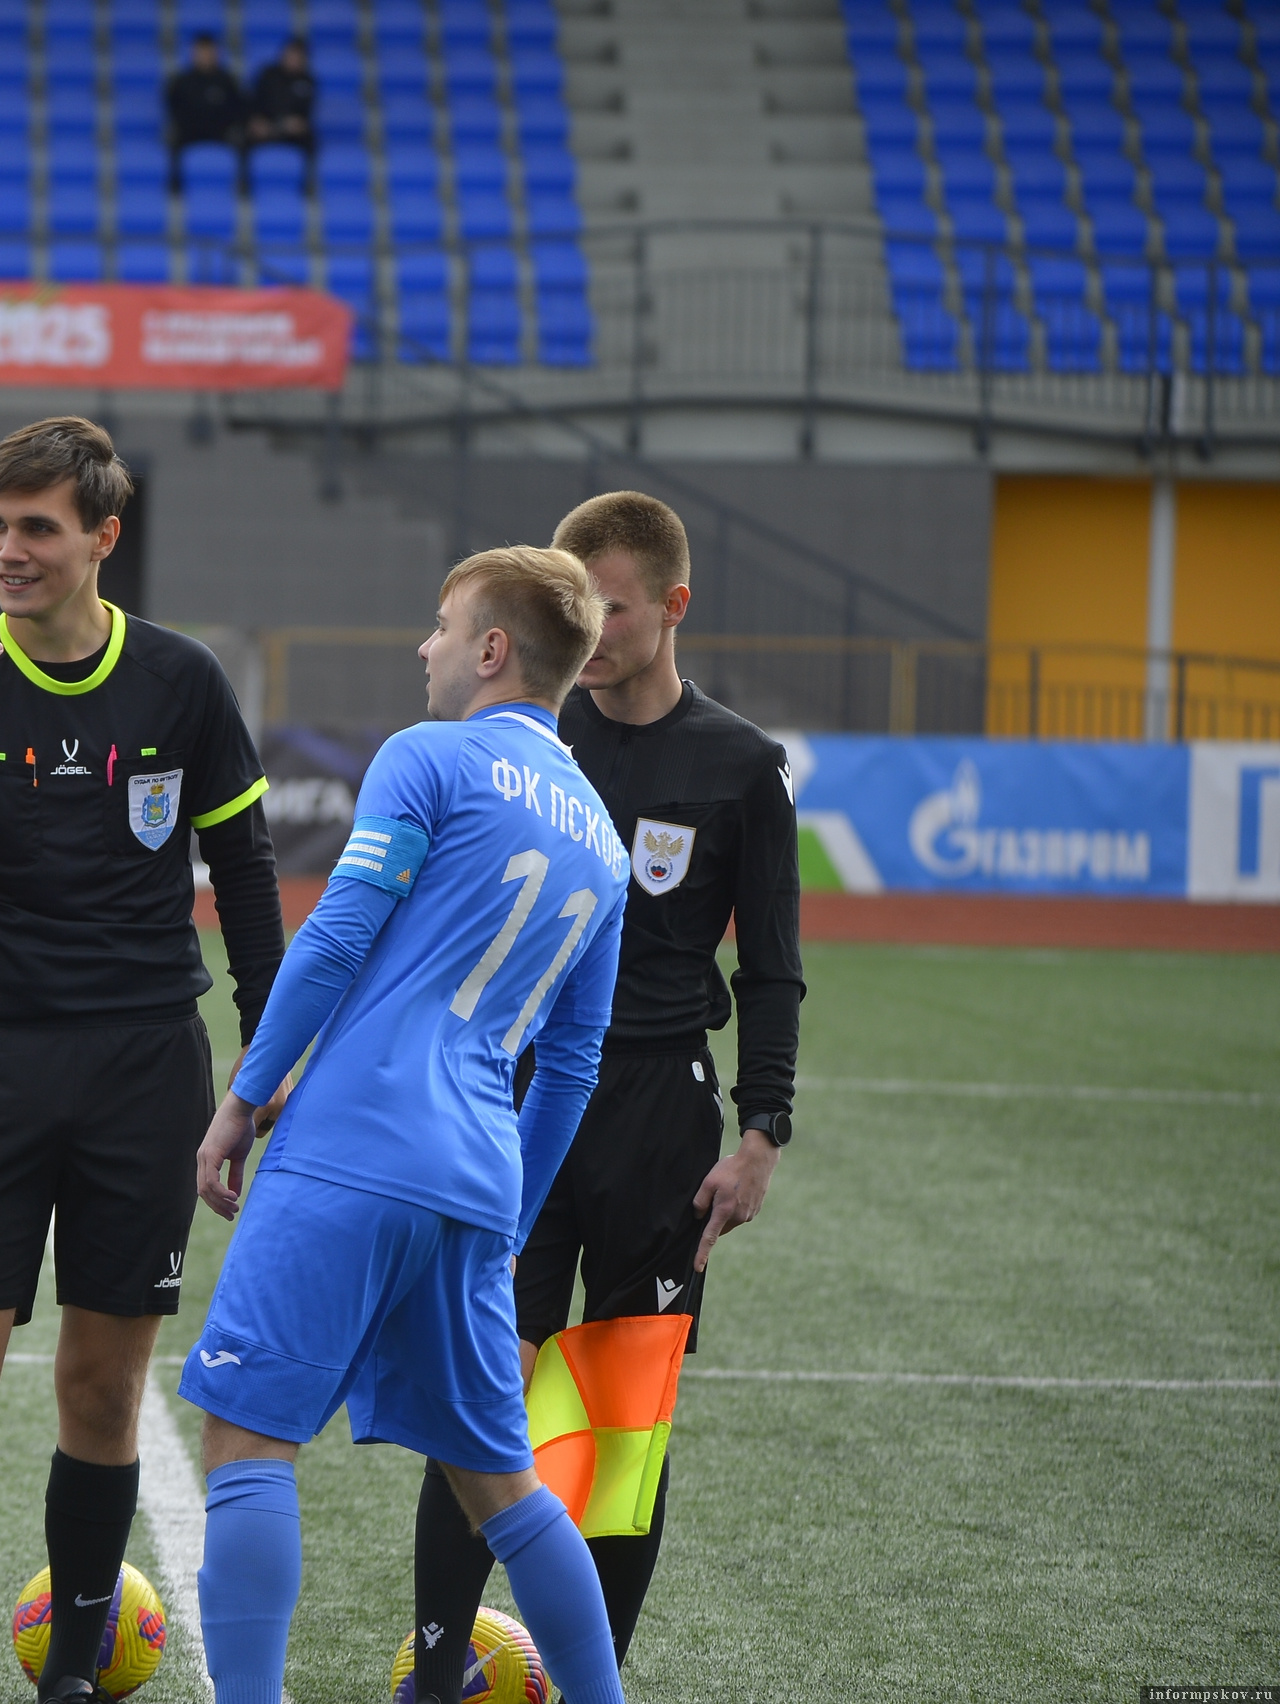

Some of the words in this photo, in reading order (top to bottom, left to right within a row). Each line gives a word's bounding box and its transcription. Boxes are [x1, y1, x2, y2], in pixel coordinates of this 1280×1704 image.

[50, 764, 92, 775] JÖGEL
[492, 758, 542, 817] ФК
[550, 782, 621, 878] ПСКОВ
[449, 848, 599, 1056] 11
[154, 1277, 182, 1288] JÖGE
